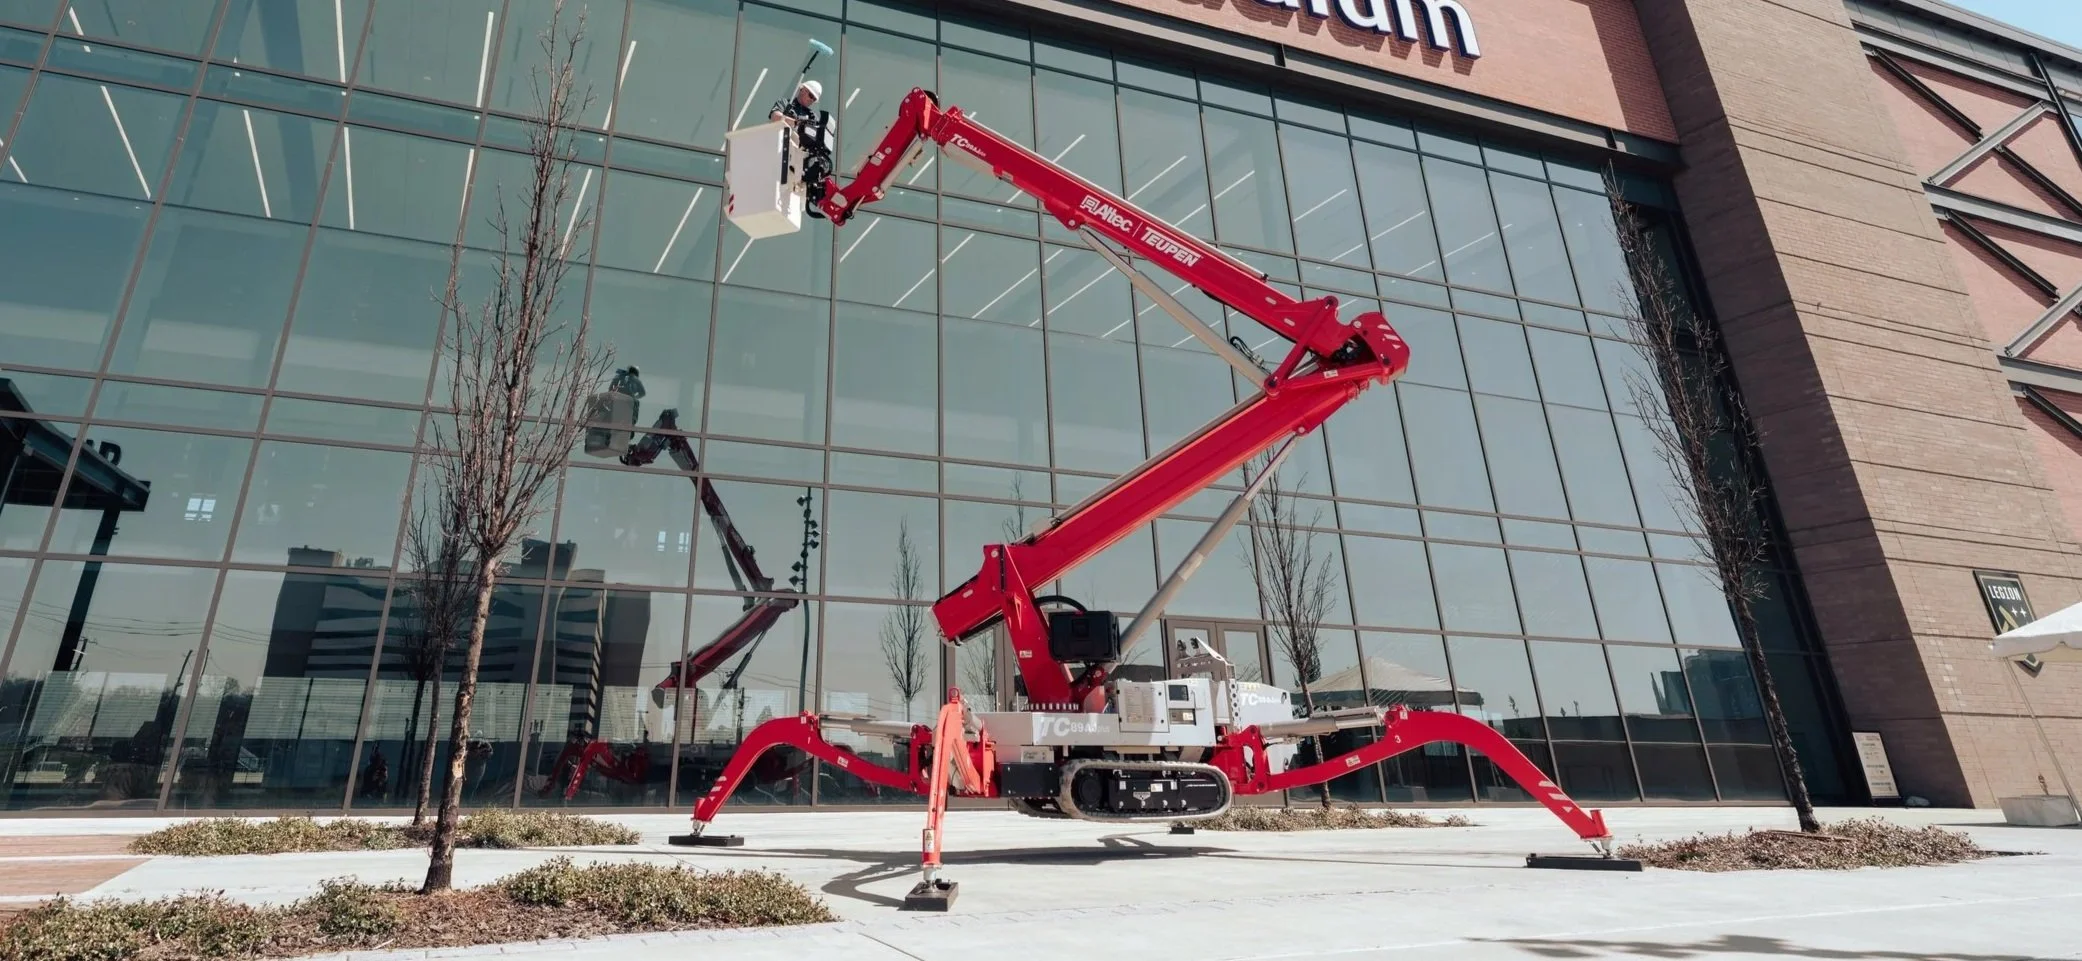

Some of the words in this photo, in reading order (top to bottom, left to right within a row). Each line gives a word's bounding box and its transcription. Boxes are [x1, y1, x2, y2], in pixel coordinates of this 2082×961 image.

[1094, 203, 1133, 232] Altec
[1140, 226, 1202, 268] TEUPEN
[1988, 585, 2022, 600] LEGION
